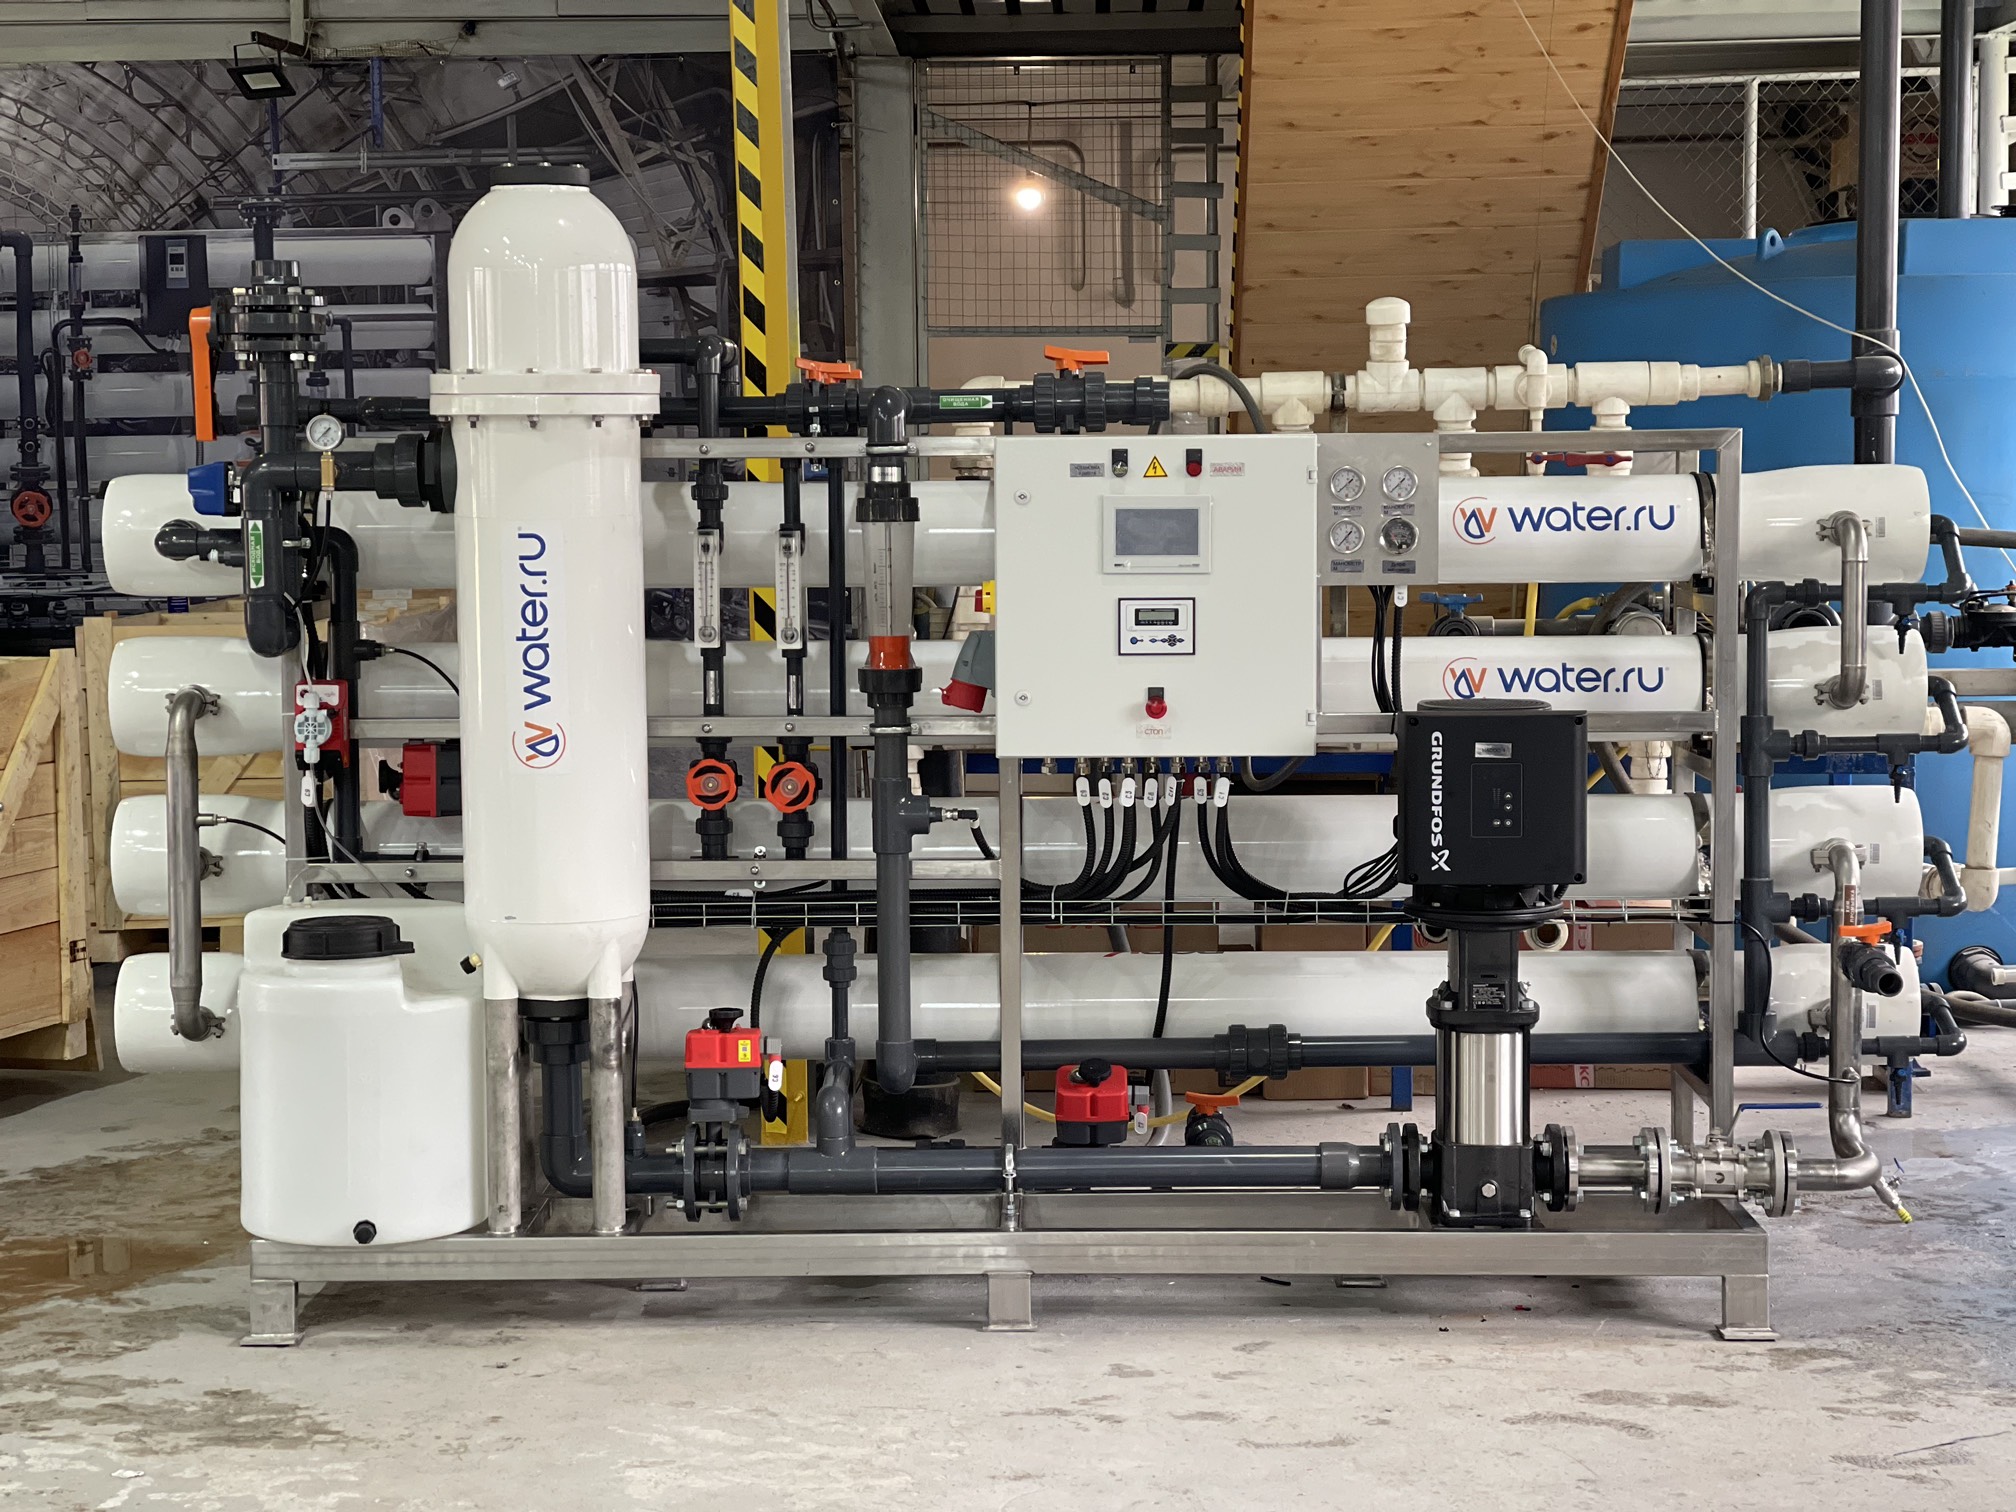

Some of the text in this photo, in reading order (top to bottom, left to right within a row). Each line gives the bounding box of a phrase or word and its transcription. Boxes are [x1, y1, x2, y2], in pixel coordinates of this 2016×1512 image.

[1507, 501, 1675, 532] water.ru
[515, 533, 552, 711] water.ru
[1497, 662, 1664, 693] water.ru
[1144, 728, 1164, 736] СТОП
[1431, 731, 1443, 847] GRUNDFOS
